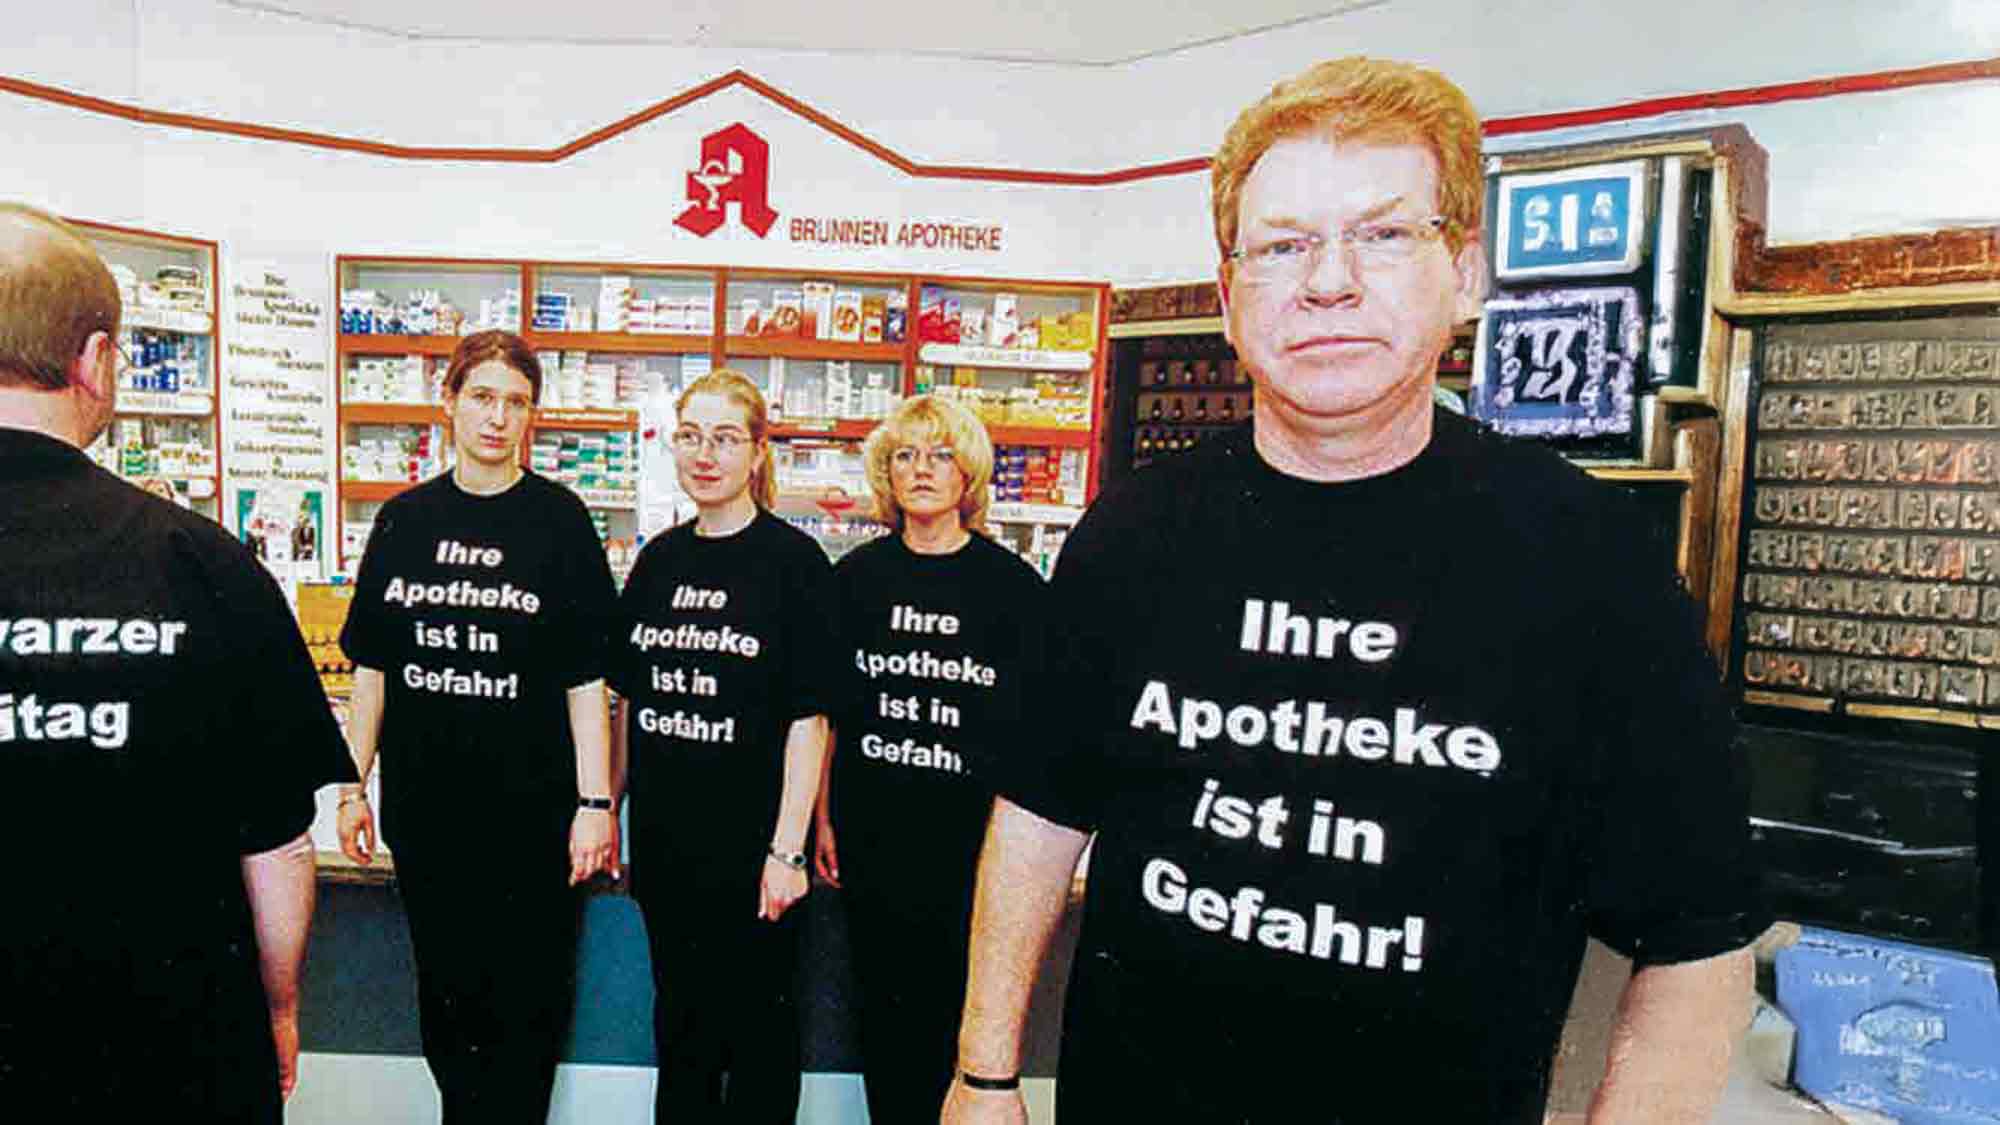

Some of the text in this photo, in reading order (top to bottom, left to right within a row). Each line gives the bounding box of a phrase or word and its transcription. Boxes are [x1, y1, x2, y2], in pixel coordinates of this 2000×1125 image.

[789, 217, 1003, 250] BRUNNEN APOTHEKE
[436, 540, 503, 567] Ihre
[384, 577, 540, 614] Apotheke
[671, 584, 728, 609] Ihre
[0, 617, 187, 655] arzer
[415, 621, 499, 652] ist in
[891, 605, 960, 635] Ihre
[1240, 599, 1398, 662] Ihre
[403, 663, 518, 699] Gefahr!
[652, 665, 718, 696] ist in
[638, 707, 735, 743] Gefahr!
[879, 692, 960, 727] ist in
[1130, 680, 1501, 778] Apotheke
[1192, 778, 1385, 865] ist in
[1142, 857, 1425, 972] Gefahr!
